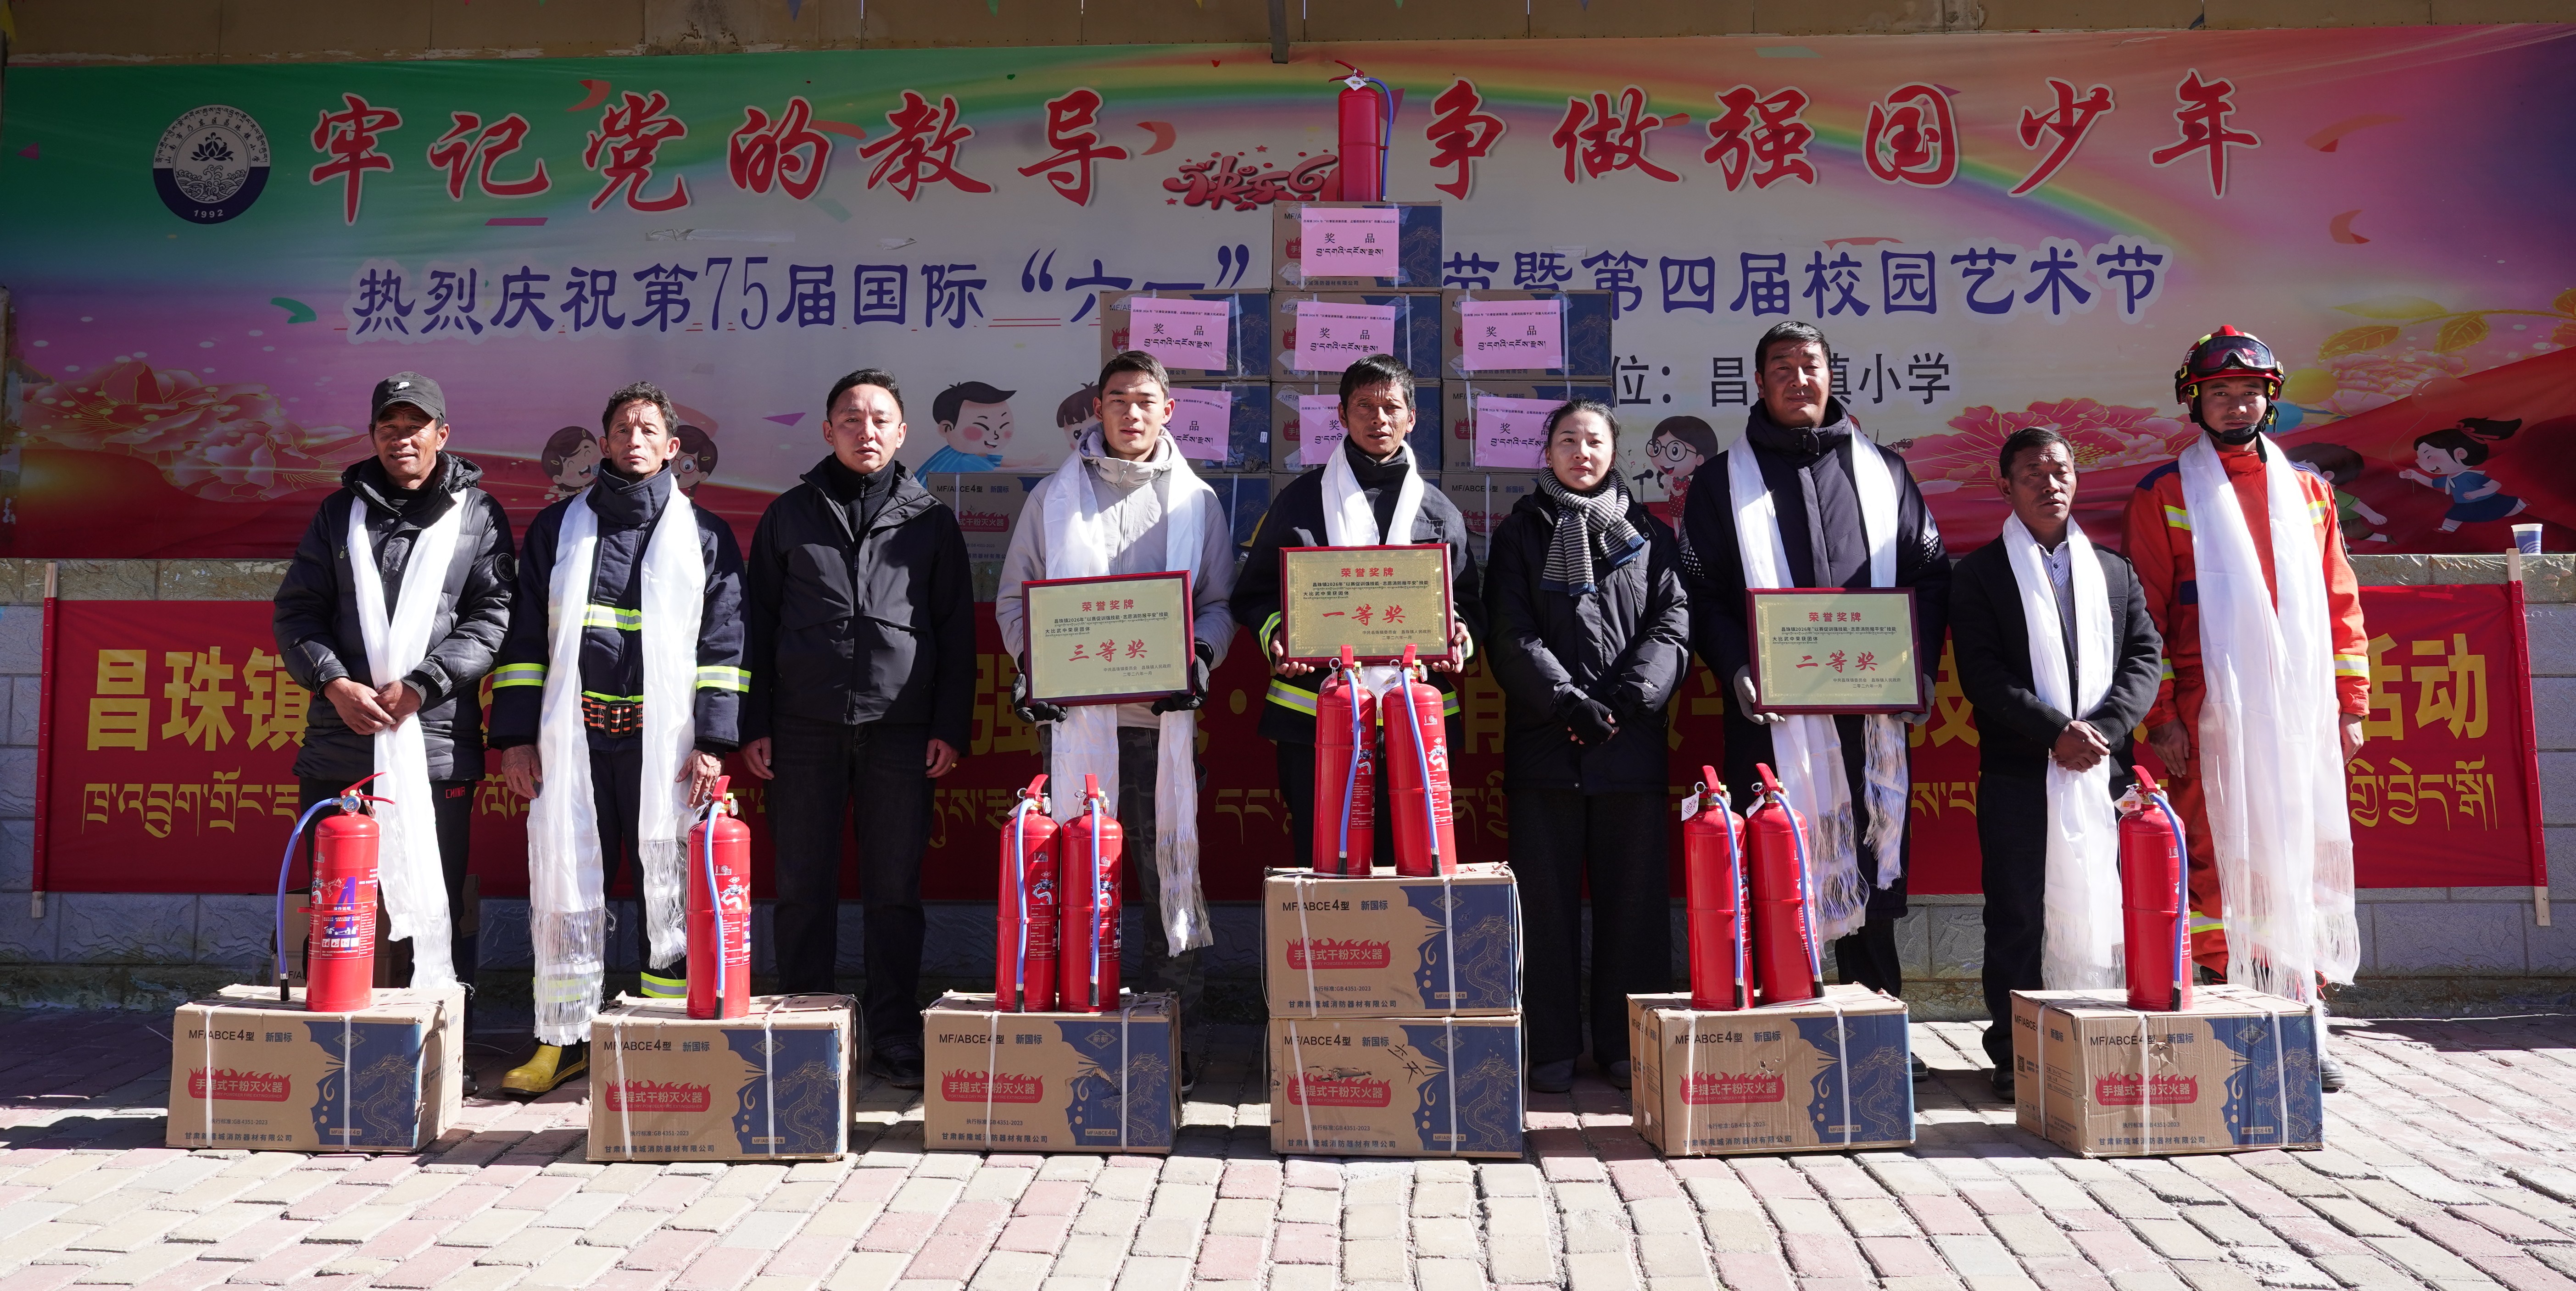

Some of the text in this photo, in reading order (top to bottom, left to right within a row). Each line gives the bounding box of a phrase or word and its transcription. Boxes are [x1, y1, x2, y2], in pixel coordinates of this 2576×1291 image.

[312, 69, 2260, 224] 牢记党的教导 争做强国少年
[194, 209, 224, 218] 1992
[1341, 567, 1394, 578] 荣誉奖牌
[1082, 599, 1134, 612] 荣誉奖牌
[1322, 604, 1406, 626] 一等奖
[1808, 612, 1862, 623] 荣誉奖牌
[1069, 639, 1148, 662] 三等奖
[1796, 650, 1878, 673] 二等奖
[86, 646, 311, 751] 昌珠镇
[446, 786, 465, 799] CHINA
[1361, 900, 1388, 911] 新国标
[265, 1032, 292, 1042] 新国标
[1015, 1034, 1043, 1045] 新国标
[1362, 1036, 1389, 1047] 新国标
[1754, 1031, 1781, 1042] 新国标
[2167, 1033, 2194, 1044] 新国标
[682, 1041, 710, 1052] 新国标
[948, 1081, 1036, 1095] 手提式干粉灭火器
[1688, 1082, 1777, 1096] 手提式干粉灭火器
